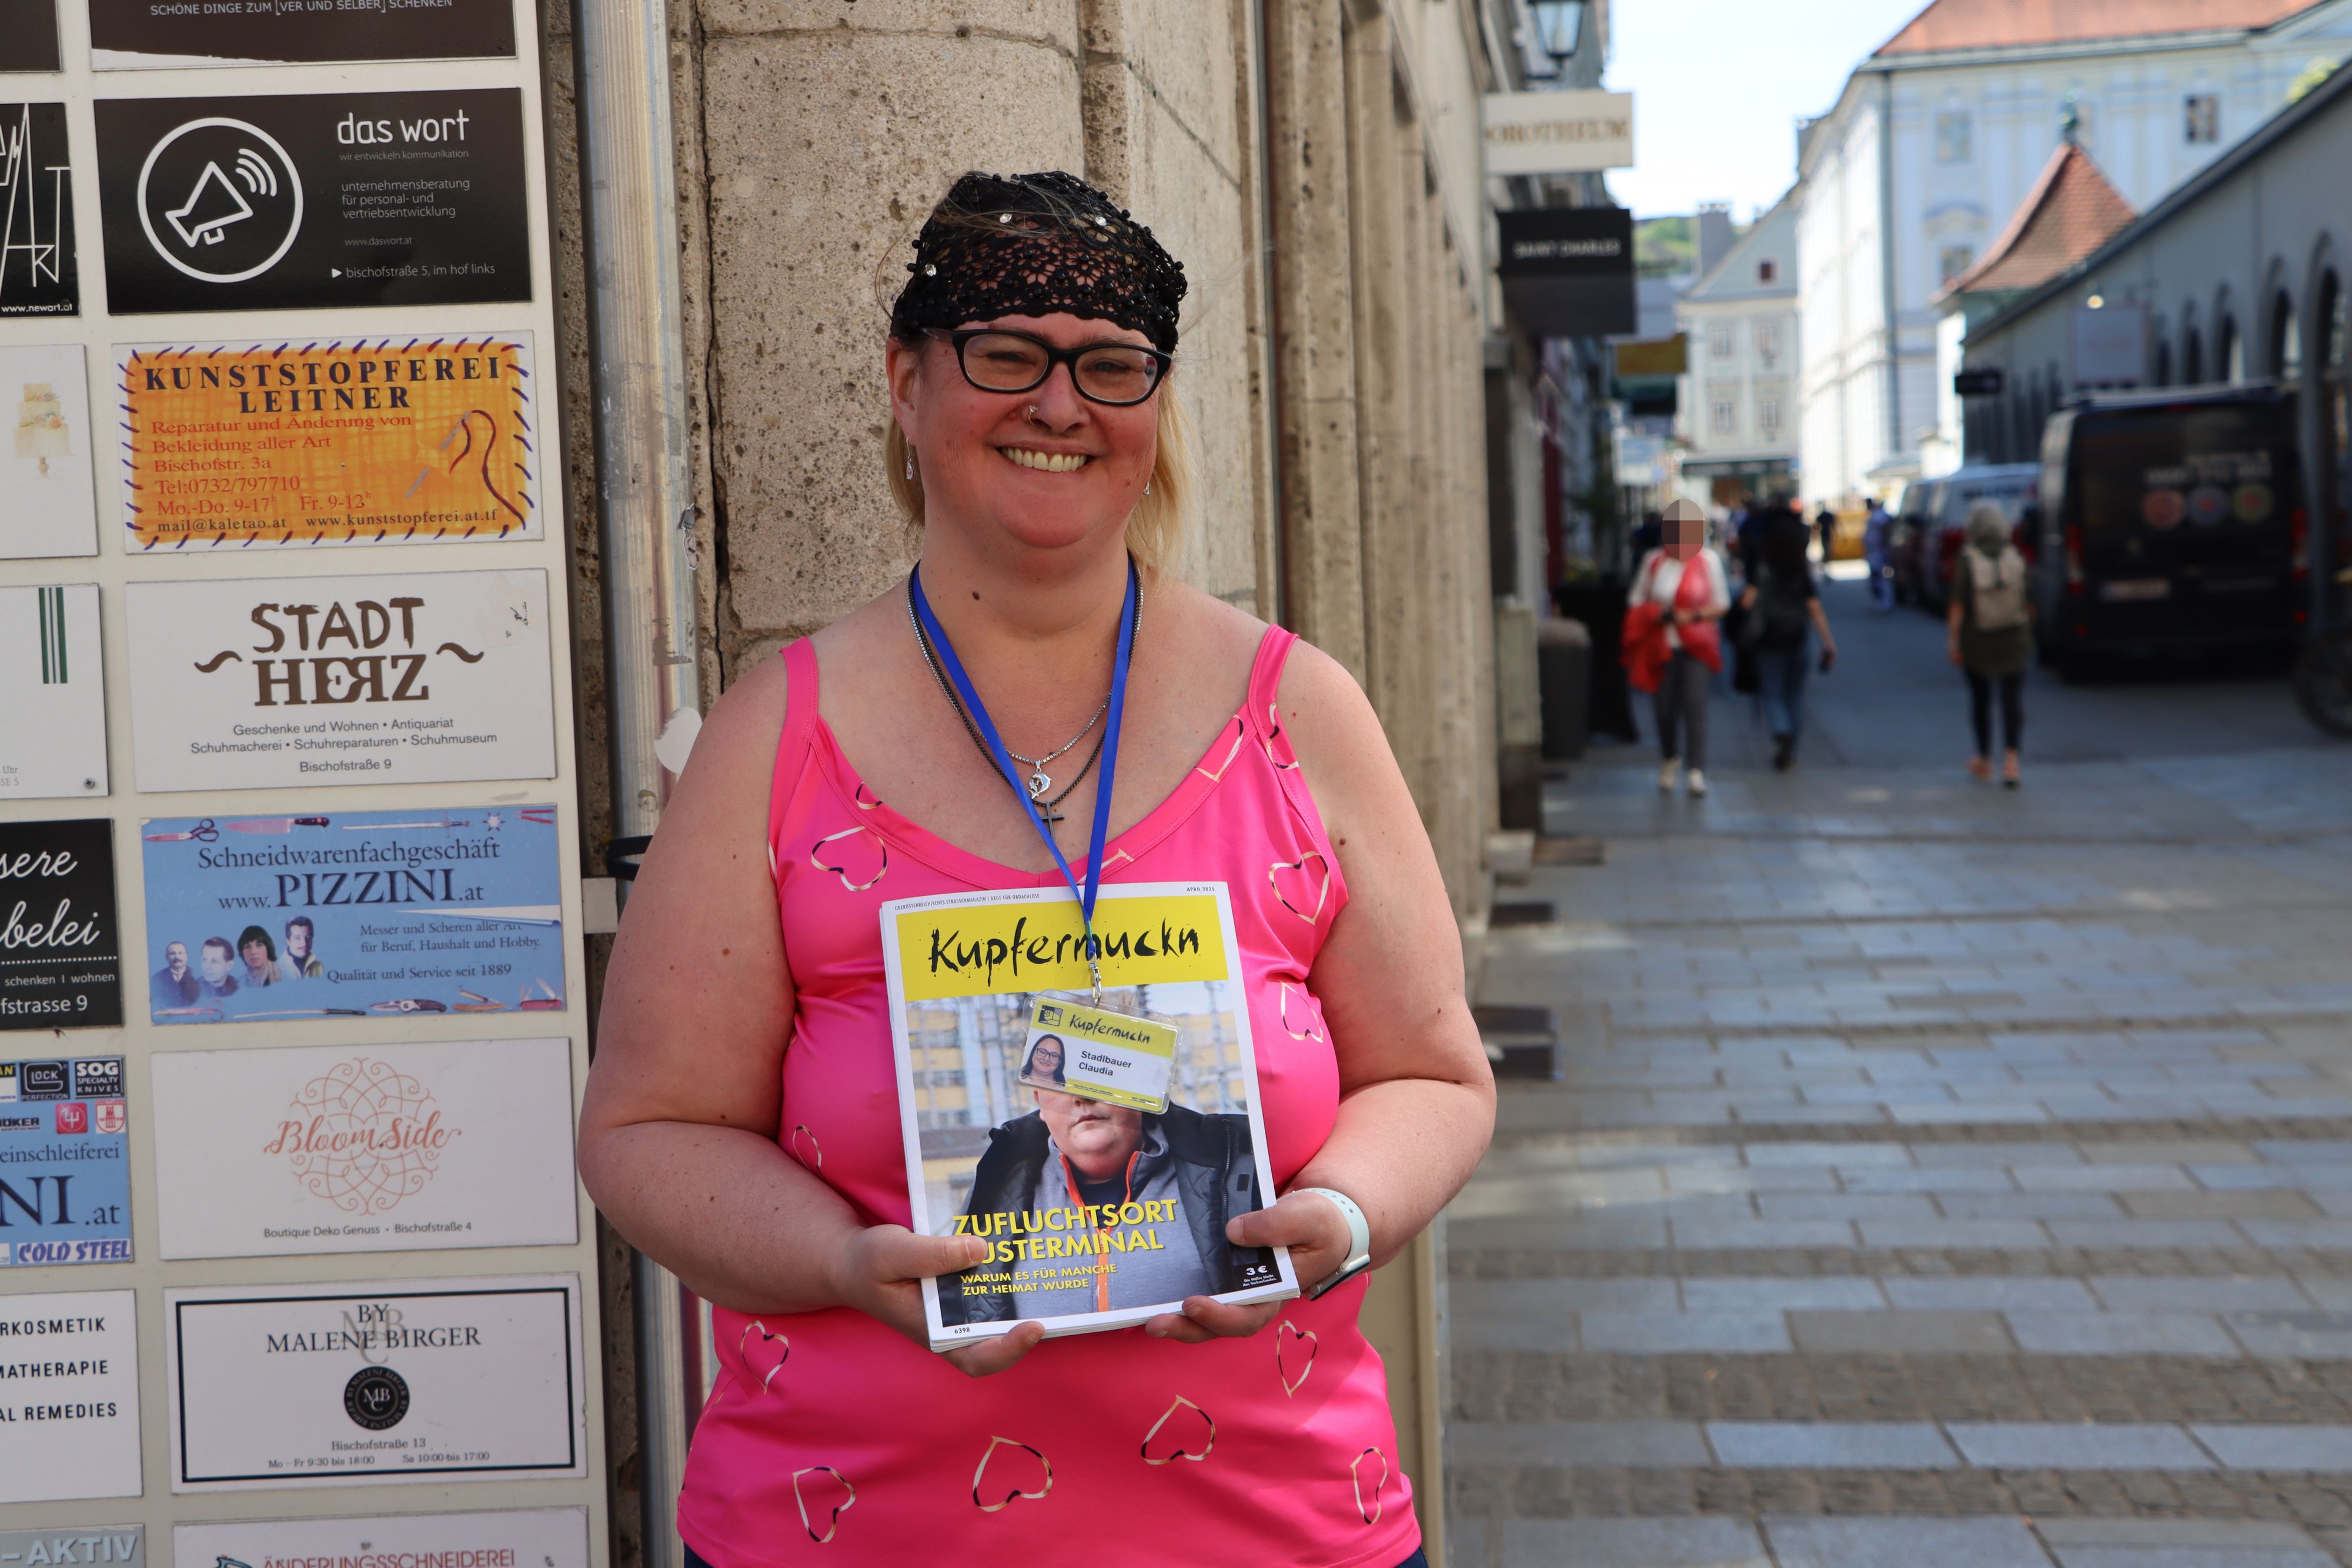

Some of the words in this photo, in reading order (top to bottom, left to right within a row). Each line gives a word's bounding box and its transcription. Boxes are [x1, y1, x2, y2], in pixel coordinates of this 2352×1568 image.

[151, 2, 200, 16] SCHÖNE
[204, 2, 242, 14] DINGE
[246, 2, 272, 13] ZUM
[307, 0, 333, 11] UND
[389, 0, 453, 9] SCHENKEN
[337, 112, 393, 144] das
[399, 109, 470, 142] wort
[354, 151, 400, 161] entwickeln
[402, 149, 469, 159] kommunikation
[341, 179, 470, 192] unternehmensberatung
[342, 195, 357, 206] für
[360, 193, 410, 207] personal-
[412, 192, 434, 203] und
[343, 206, 456, 219] vertriebsentwicklung
[344, 236, 413, 246] www.daswort.at
[346, 265, 419, 278] bischofstraße
[421, 266, 431, 278] 5,
[433, 265, 447, 275] im
[450, 263, 469, 275] hof
[471, 263, 496, 274] links
[1, 302, 73, 313] www.newart.at
[145, 356, 500, 390] KUNSTSTOPFEREI
[238, 386, 411, 413] LEITNER
[151, 421, 242, 437] Reparatur
[246, 417, 280, 431] und
[286, 414, 375, 430] Änderung
[379, 416, 412, 427] von
[152, 439, 253, 454] Bekleidung
[257, 437, 297, 450] aller
[301, 436, 332, 449] Art
[153, 457, 245, 473] Bischofstr.
[250, 457, 271, 469] 3a
[155, 475, 300, 496] Tel:0732/797710
[157, 499, 229, 516] Mo.-Do.
[299, 496, 323, 511] Fr.
[157, 518, 287, 533] mail@kaletao.at
[306, 509, 498, 526] www.kunststopferei.at.tf
[251, 596, 425, 654] STADT
[252, 653, 430, 706] HERZ
[232, 721, 300, 736] Geschenke
[304, 721, 326, 734] und
[329, 720, 379, 733] Wohnen
[391, 717, 454, 732] Antiquariat
[191, 740, 283, 754] Schuhmacherei
[294, 737, 399, 751] Schuhreparaturen
[410, 733, 498, 747] Schuhmuseum
[2, 765, 18, 774] Uhr
[299, 759, 380, 773] Bischofstraße
[384, 758, 392, 769] 9
[14, 777, 19, 786] 5
[198, 836, 501, 869] Schneidwarenfachgeschäft
[894, 899, 946, 911] OBERÖSTERREICHISCHES
[946, 896, 987, 905] STRASSENMAGAZIN
[1002, 892, 1011, 901] FÜR
[360, 924, 400, 936] Messer
[403, 922, 425, 934] und
[429, 920, 473, 934] Scheren
[476, 920, 500, 932] aller
[360, 942, 376, 953] für
[419, 938, 470, 951] Haushalt
[473, 937, 496, 949] und
[499, 936, 541, 951] Hobby.
[928, 917, 1199, 987] Kupfermuckn
[5, 974, 56, 987] schenken
[71, 972, 115, 984] wohnen
[327, 967, 377, 984] Qualität
[381, 966, 405, 979] und
[409, 965, 452, 978] Service
[455, 964, 476, 977] seit
[480, 964, 512, 977] 1889
[76, 994, 88, 1011] 9
[1069, 1014, 1151, 1044] Kupfermuckn
[1081, 1050, 1132, 1069] Stadlbauer
[76, 1061, 119, 1077] SOG
[1078, 1062, 1114, 1076] Claudia
[77, 1076, 119, 1085] SPECIALTY
[77, 1085, 119, 1093] KNIVES
[952, 1199, 1177, 1237] ZUFLUCHTSORT
[264, 1228, 311, 1239] Boutique
[313, 1226, 341, 1236] Deko
[343, 1225, 381, 1235] Genuss
[395, 1222, 463, 1233] Bischofstraße
[465, 1222, 472, 1231] 4
[19, 1242, 71, 1262] COLD
[76, 1238, 131, 1261] STEEL
[960, 1272, 1011, 1284] WARUM
[1015, 1271, 1030, 1281] ES
[1033, 1266, 1058, 1279] FÜR
[1061, 1263, 1117, 1278] MANCHE
[1246, 1267, 1256, 1276] 3
[1257, 1265, 1268, 1273] €
[963, 1285, 988, 1296] ZUR
[992, 1282, 1038, 1295] HEIMAT
[1044, 1278, 1089, 1291] WURDE
[358, 1303, 389, 1323] BY
[954, 1326, 971, 1335] 6398
[266, 1330, 377, 1353] MALENE
[386, 1326, 482, 1349] BIRGER
[25, 1402, 117, 1421] REMEDIES
[331, 1439, 409, 1452] Bischofstraße
[413, 1438, 427, 1449] 13
[269, 1459, 283, 1469] Mo
[294, 1458, 305, 1467] Fr
[308, 1457, 329, 1467] 9:30
[332, 1456, 346, 1466] bis
[349, 1455, 375, 1465] 18:00
[403, 1455, 415, 1463] Sa
[418, 1453, 445, 1463] 10:00
[463, 1452, 490, 1462] 17:00
